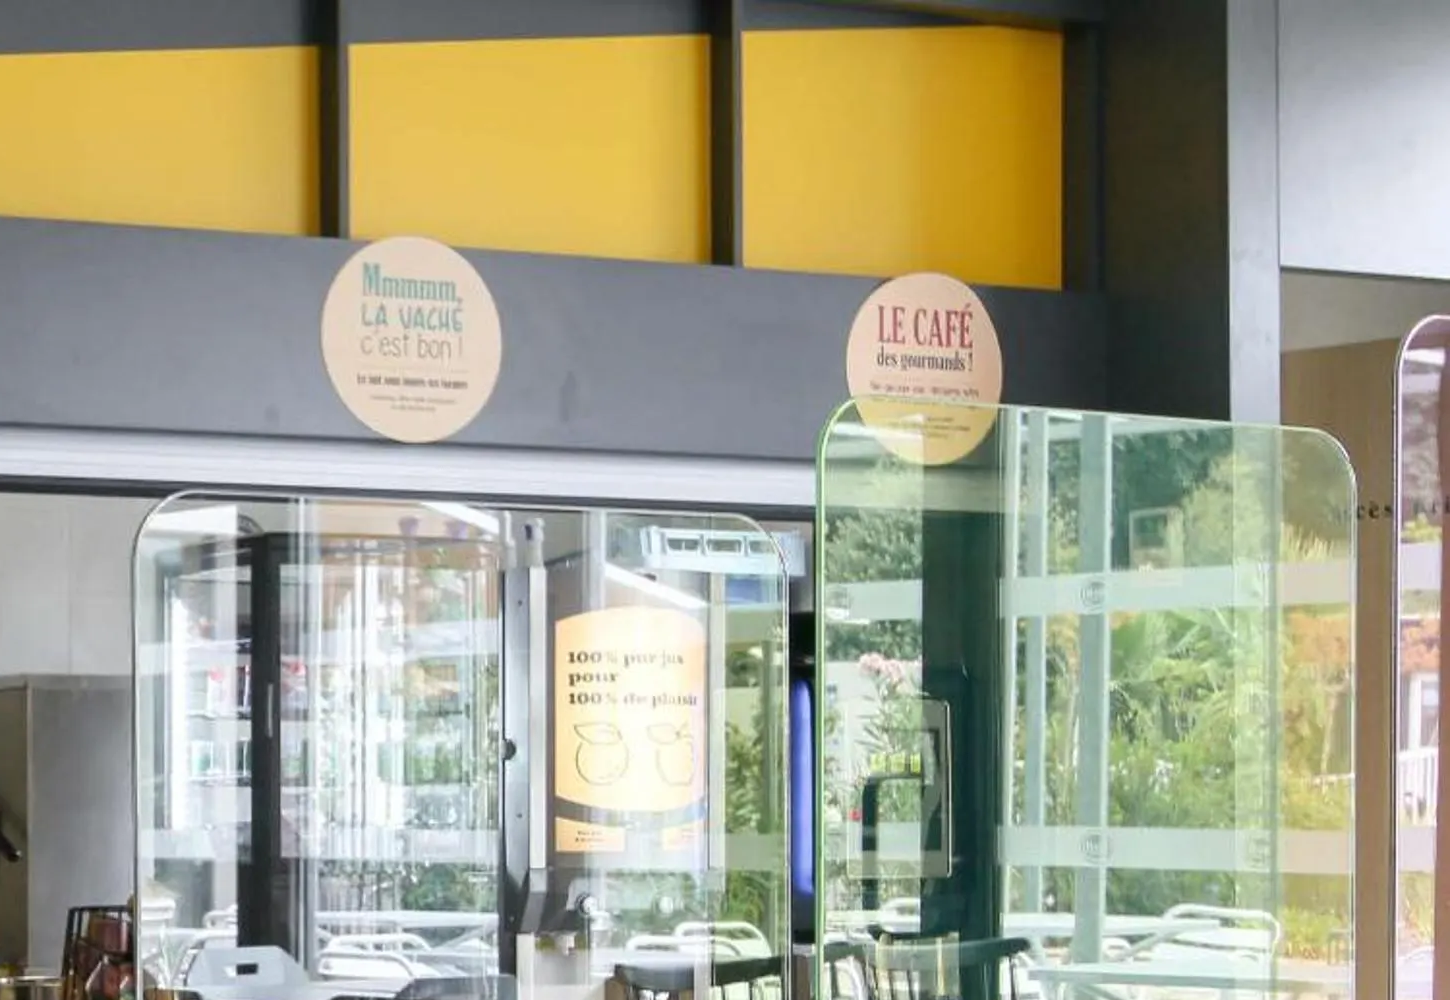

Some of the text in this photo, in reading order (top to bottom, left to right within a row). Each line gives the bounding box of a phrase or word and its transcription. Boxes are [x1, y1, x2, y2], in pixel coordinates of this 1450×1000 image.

[361, 303, 463, 332] LA VACHE
[878, 303, 973, 349] LE CAFÉ
[417, 335, 452, 361] bon
[877, 344, 898, 366] des
[900, 350, 965, 371] gourmands
[568, 673, 620, 686] pour
